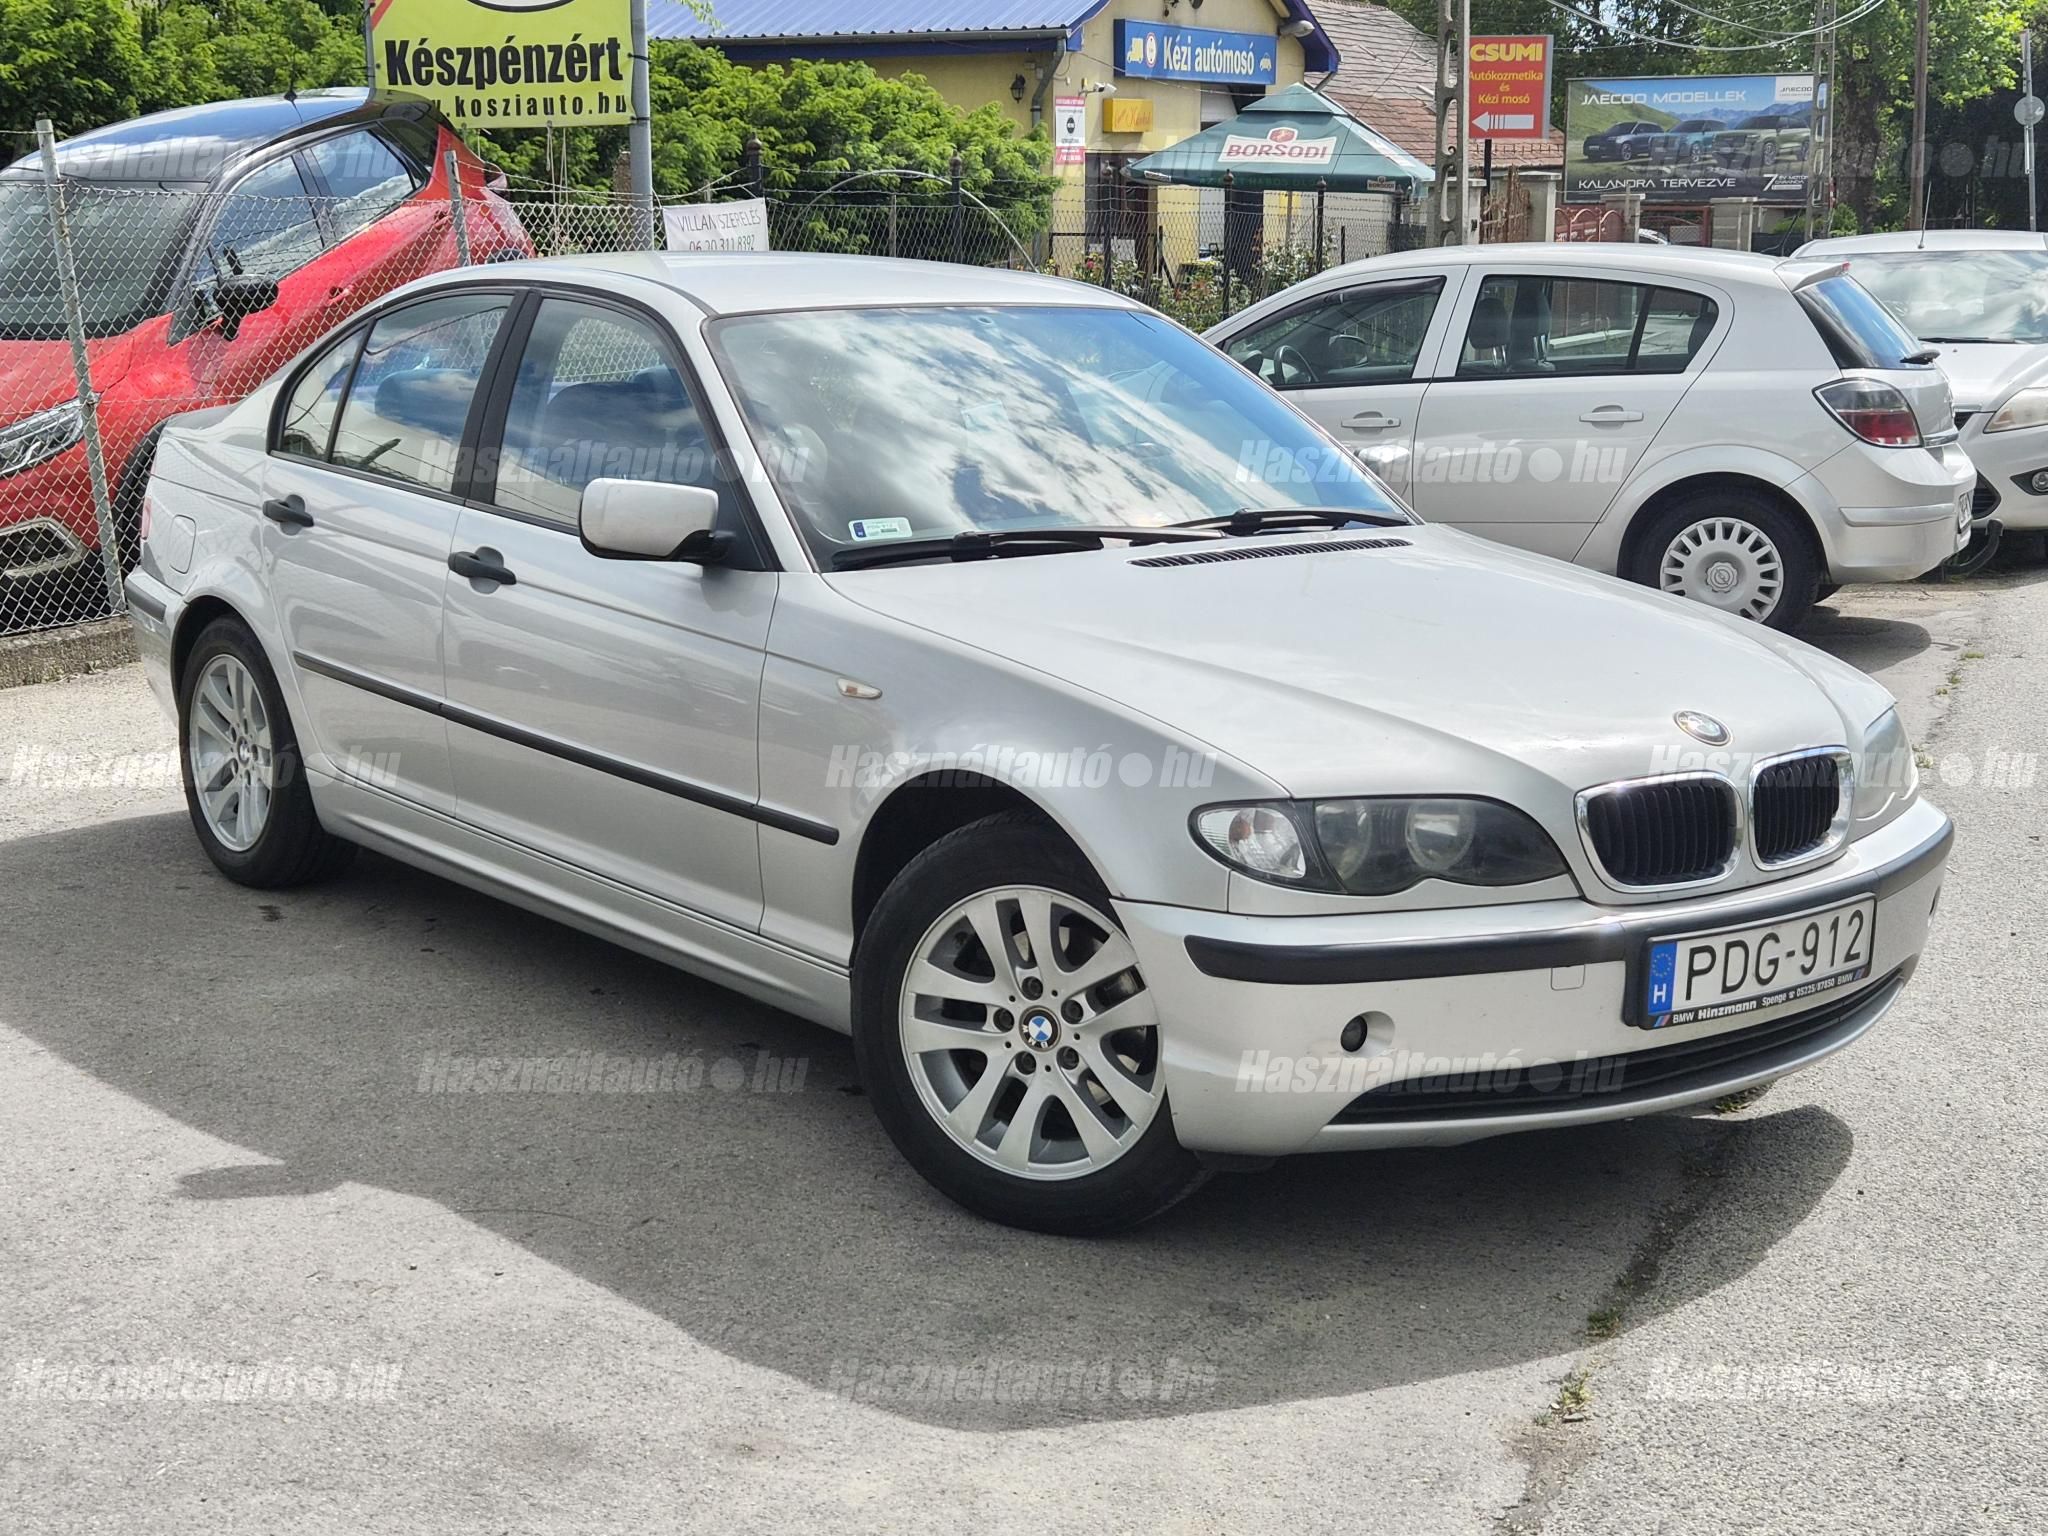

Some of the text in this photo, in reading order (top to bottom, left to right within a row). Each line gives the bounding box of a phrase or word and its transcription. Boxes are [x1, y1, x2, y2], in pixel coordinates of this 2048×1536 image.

[384, 33, 624, 90] Készpénzért
[1163, 34, 1255, 75] Kézi autómosó
[1470, 43, 1543, 62] CSUMI
[1469, 70, 1544, 81] Autókozmetika
[1499, 81, 1510, 92] és
[1478, 93, 1530, 104] Kézi mosó
[1581, 90, 1747, 106] JAECOO MODELLEK
[1226, 143, 1328, 159] BORSODI
[1578, 178, 1737, 189] KALANDRA TERVEZVE
[1763, 173, 1779, 191] 7
[1685, 909, 1864, 1000] PDG-912
[1653, 984, 1667, 1004] H
[1672, 1012, 1694, 1024] BMW
[1698, 1000, 1757, 1020] Hinzmann
[1762, 991, 1787, 1007] Spenge
[1837, 972, 1854, 985] BMW
